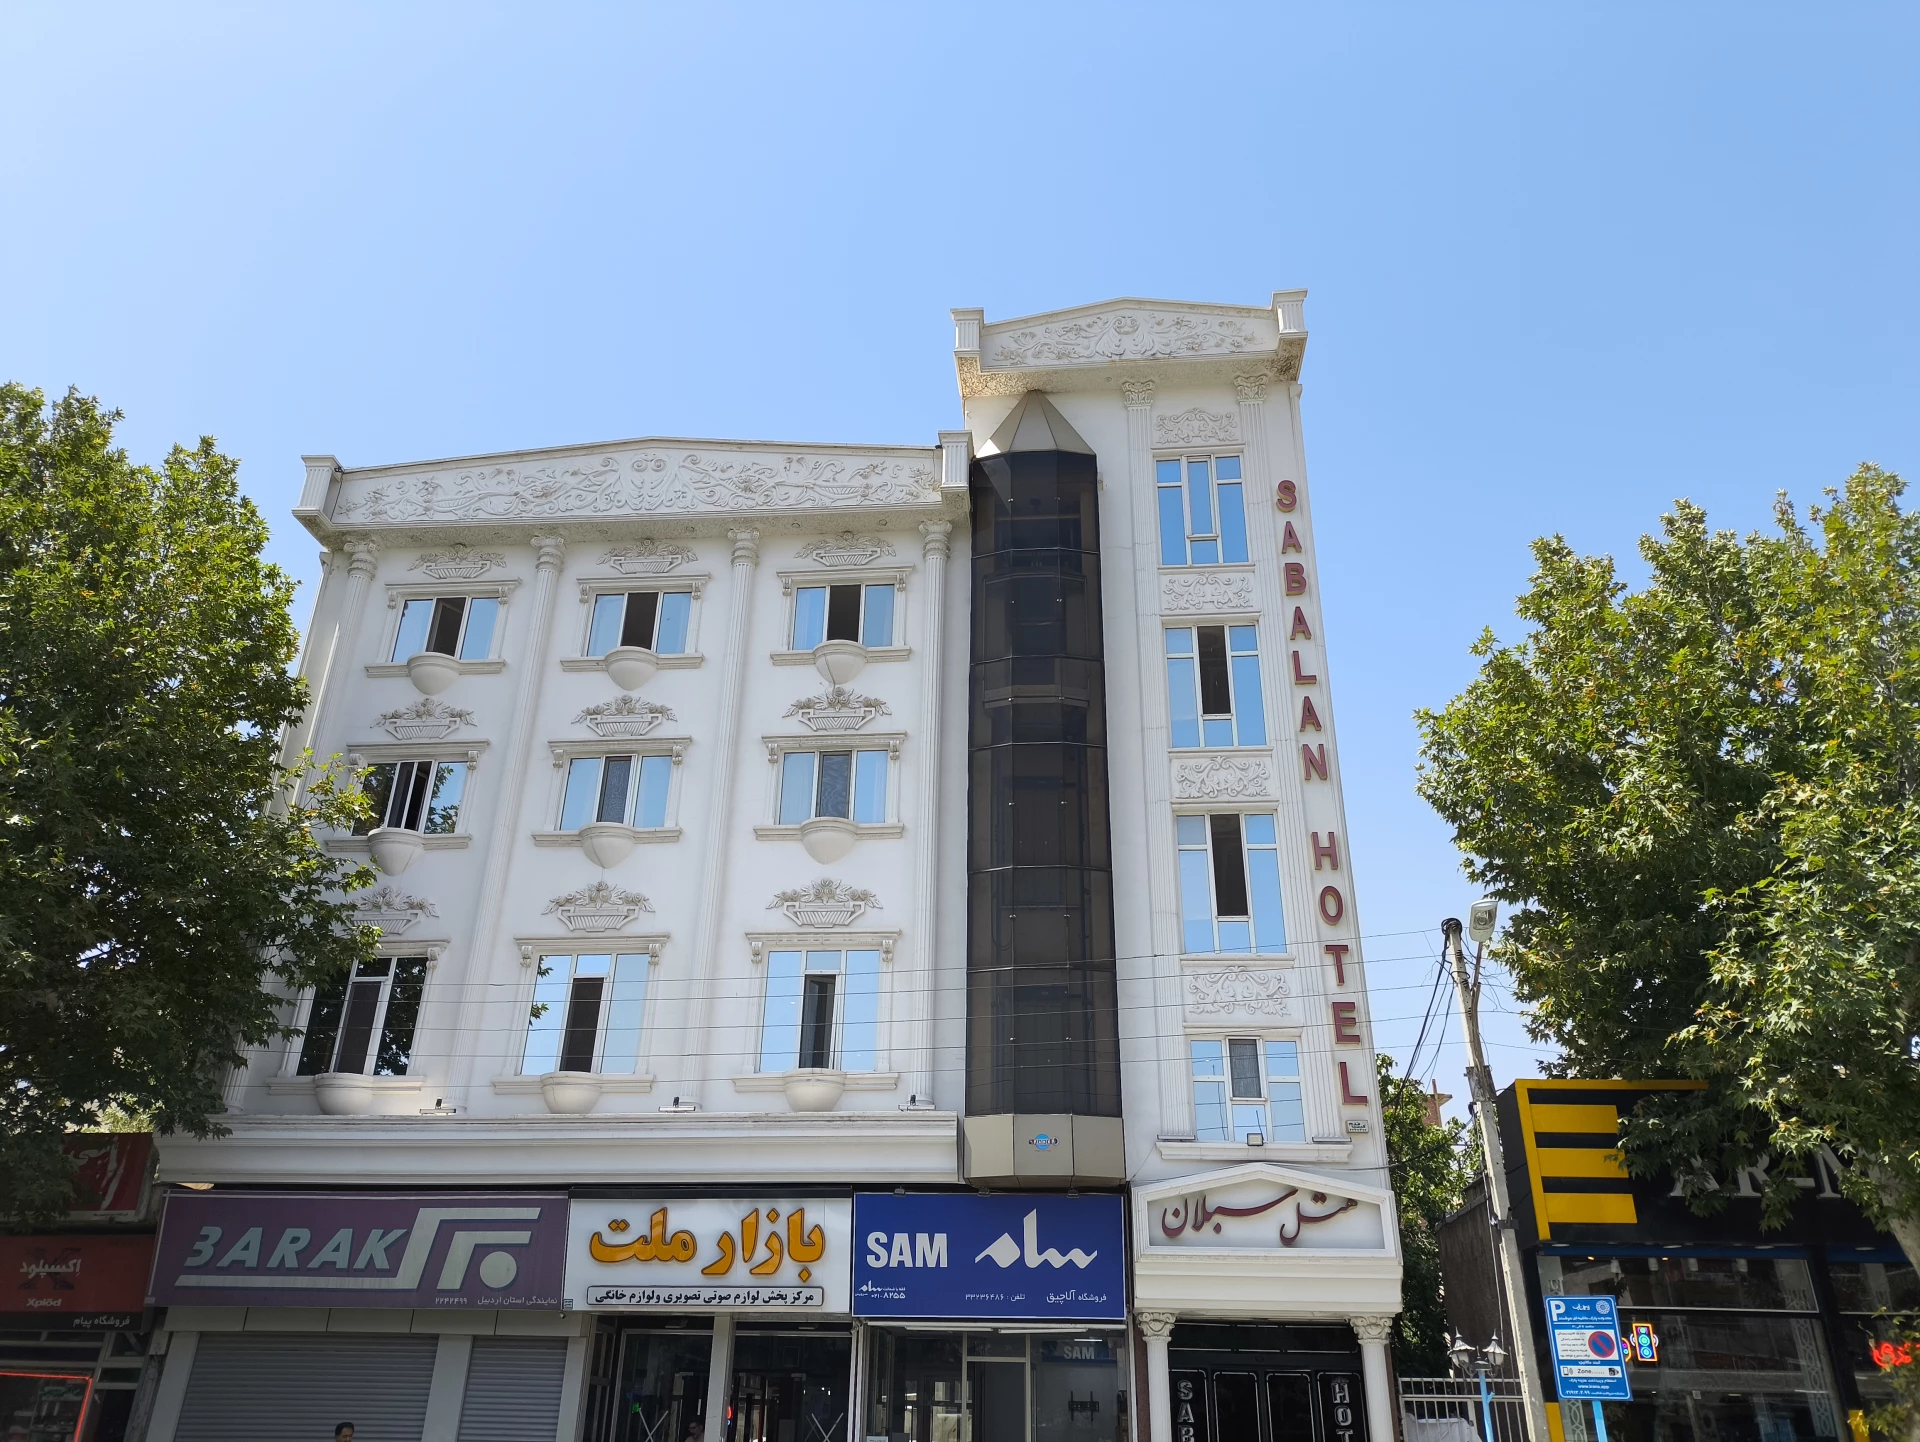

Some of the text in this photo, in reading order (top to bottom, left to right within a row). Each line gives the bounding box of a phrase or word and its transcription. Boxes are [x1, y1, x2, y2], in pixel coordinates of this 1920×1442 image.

[1276, 479, 1368, 1107] SABALAN HOTEL
[1161, 1188, 1359, 1246] هتل سبلان
[589, 1207, 826, 1283] بازار ملت
[975, 1208, 1098, 1269] سام
[866, 1231, 948, 1269] SAM
[477, 1297, 502, 1306] اردبیل
[503, 1296, 525, 1305] استان
[526, 1295, 558, 1306] نمایندگی
[594, 1290, 627, 1303] خانگی
[662, 1290, 702, 1304] تصویری
[703, 1290, 732, 1304] صوتی
[733, 1290, 760, 1304] لوازم
[762, 1290, 788, 1304] پخش
[789, 1290, 814, 1304] مرکز
[1077, 1293, 1107, 1303] فروشگاه
[1549, 1300, 1566, 1322] P
[73, 1316, 130, 1330] فروشگاه پیام
[1063, 1346, 1095, 1360] SAM
